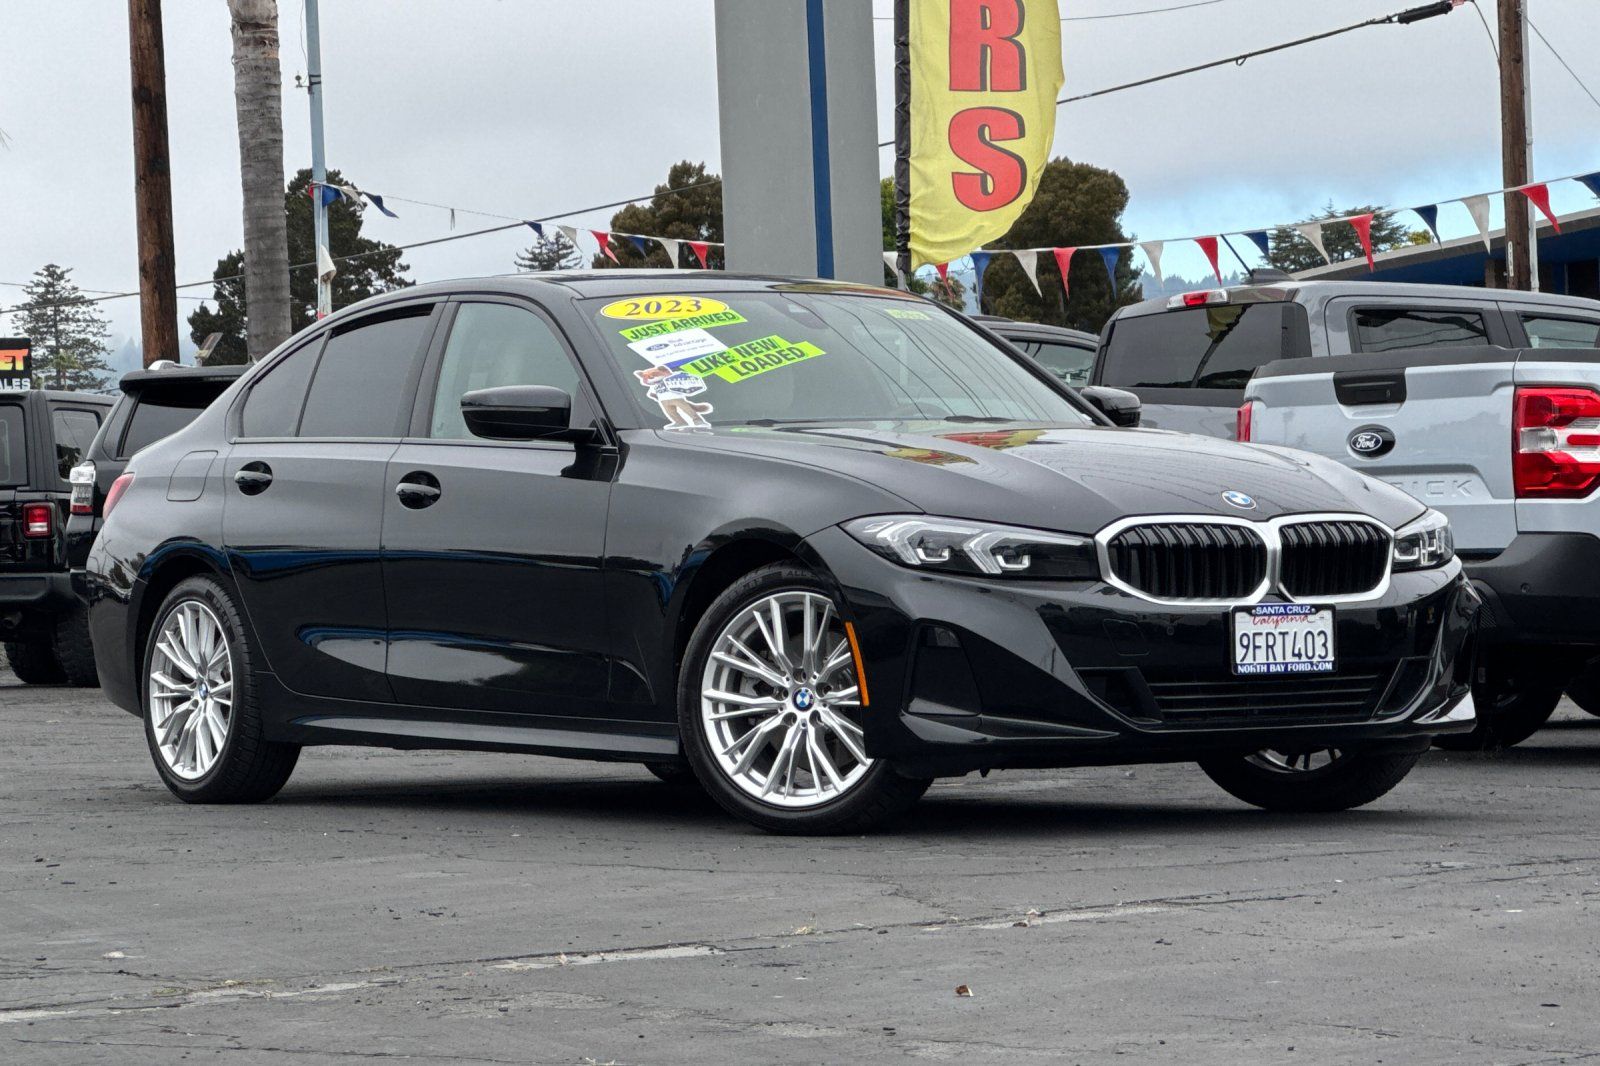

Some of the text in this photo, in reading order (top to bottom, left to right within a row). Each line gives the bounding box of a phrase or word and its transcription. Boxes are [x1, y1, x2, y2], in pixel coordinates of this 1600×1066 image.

[624, 299, 702, 317] 2023
[630, 312, 737, 339] JUST ARRIVED
[690, 351, 736, 374] LIKE
[733, 338, 781, 358] NEW
[729, 346, 806, 376] LOADED
[1355, 434, 1376, 448] Ford
[1255, 605, 1311, 615] SANTA CRUZ
[1252, 614, 1314, 629] California
[1239, 629, 1329, 662] 9FRT403
[1237, 661, 1333, 674] NORTH BAY FORD.COM
